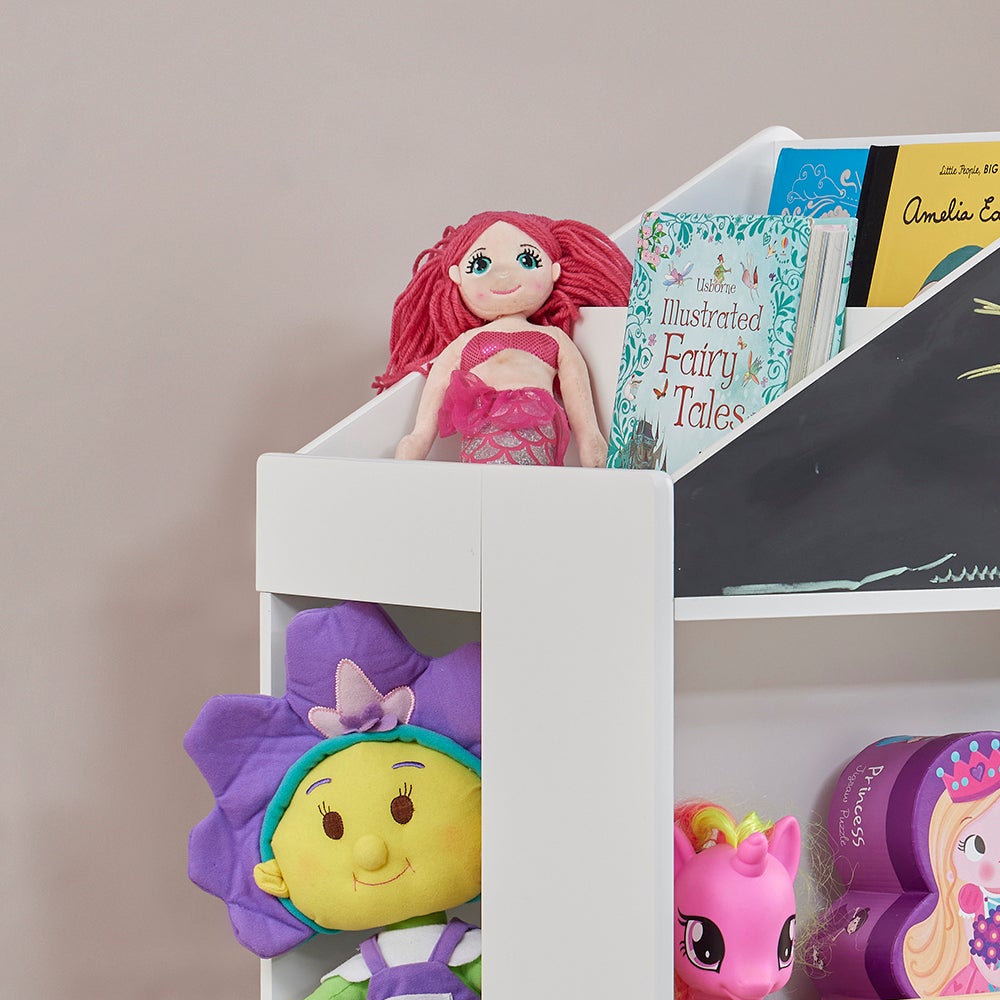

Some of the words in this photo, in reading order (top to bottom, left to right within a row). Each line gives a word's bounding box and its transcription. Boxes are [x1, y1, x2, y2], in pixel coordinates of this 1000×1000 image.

[938, 164, 958, 176] Little
[958, 164, 981, 179] People,
[983, 163, 999, 174] BIG
[902, 195, 974, 225] Amelia
[696, 277, 737, 295] Usborne
[660, 297, 764, 332] Illustrated
[658, 331, 738, 390] Fairy
[673, 385, 746, 431] Tales
[842, 764, 867, 803] Jigsaw
[851, 765, 885, 847] Princess
[839, 808, 850, 847] Puzzle
